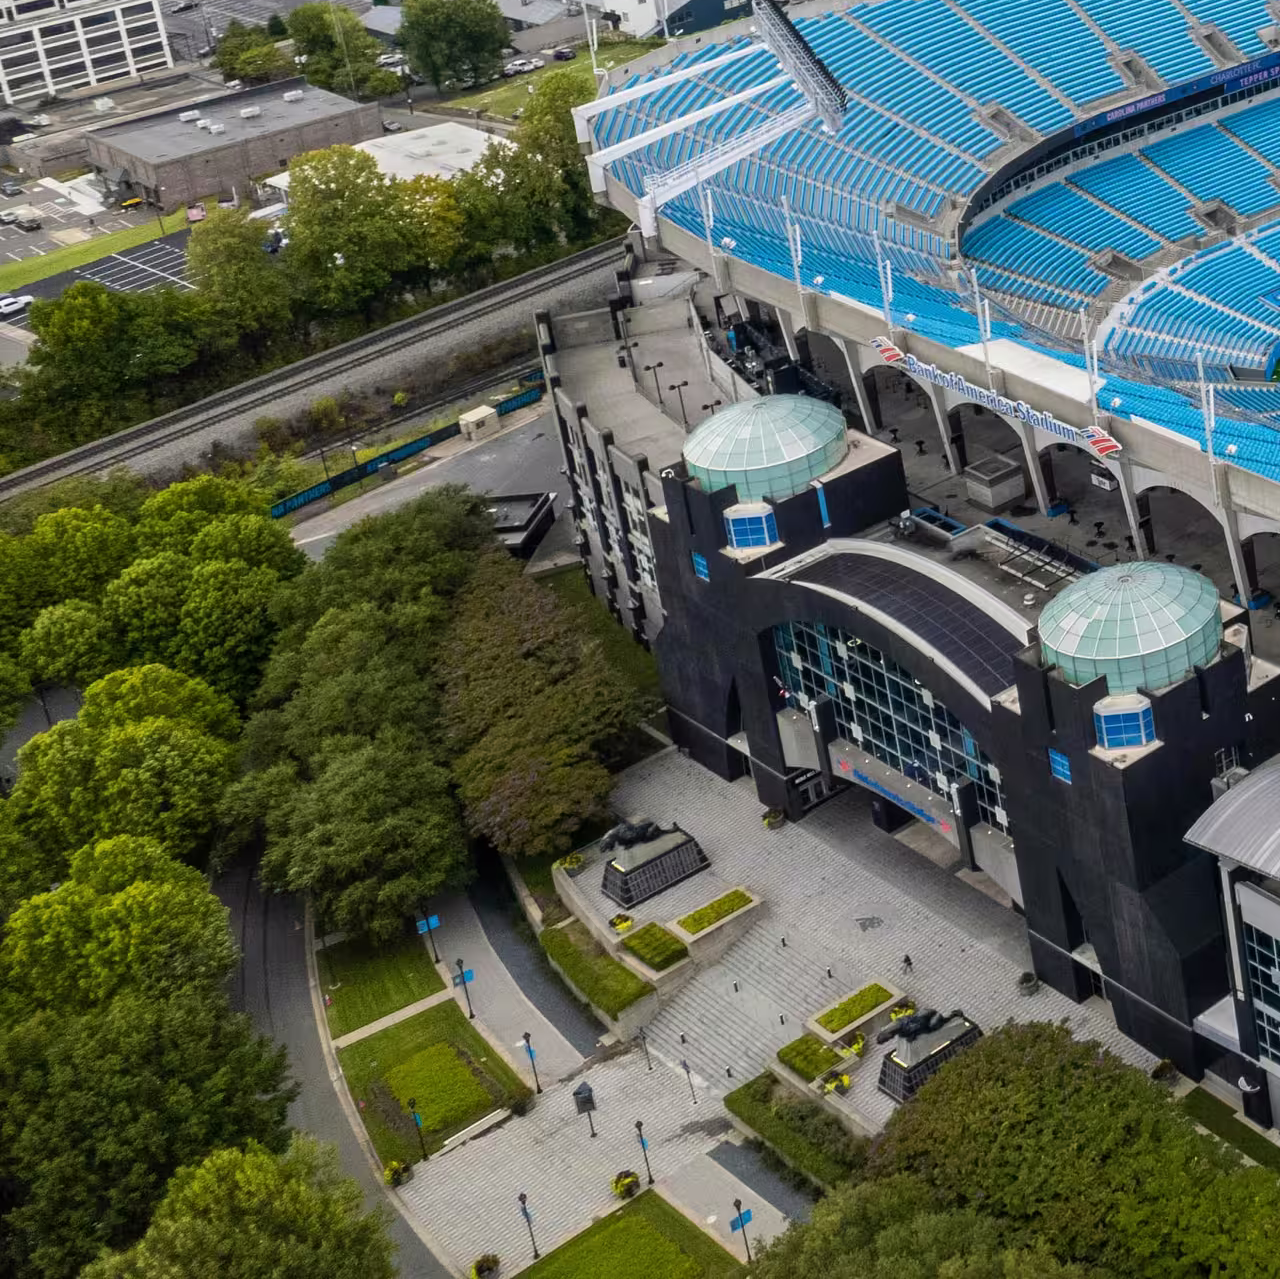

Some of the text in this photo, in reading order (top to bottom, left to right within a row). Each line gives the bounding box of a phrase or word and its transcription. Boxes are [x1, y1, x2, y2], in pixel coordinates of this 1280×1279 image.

[1210, 60, 1262, 85] CHARLOTTE FC
[1240, 71, 1268, 87] TEPPER
[1107, 94, 1166, 121] CAROLINA PANTHERS
[907, 354, 1077, 442] Bank of America Stadium
